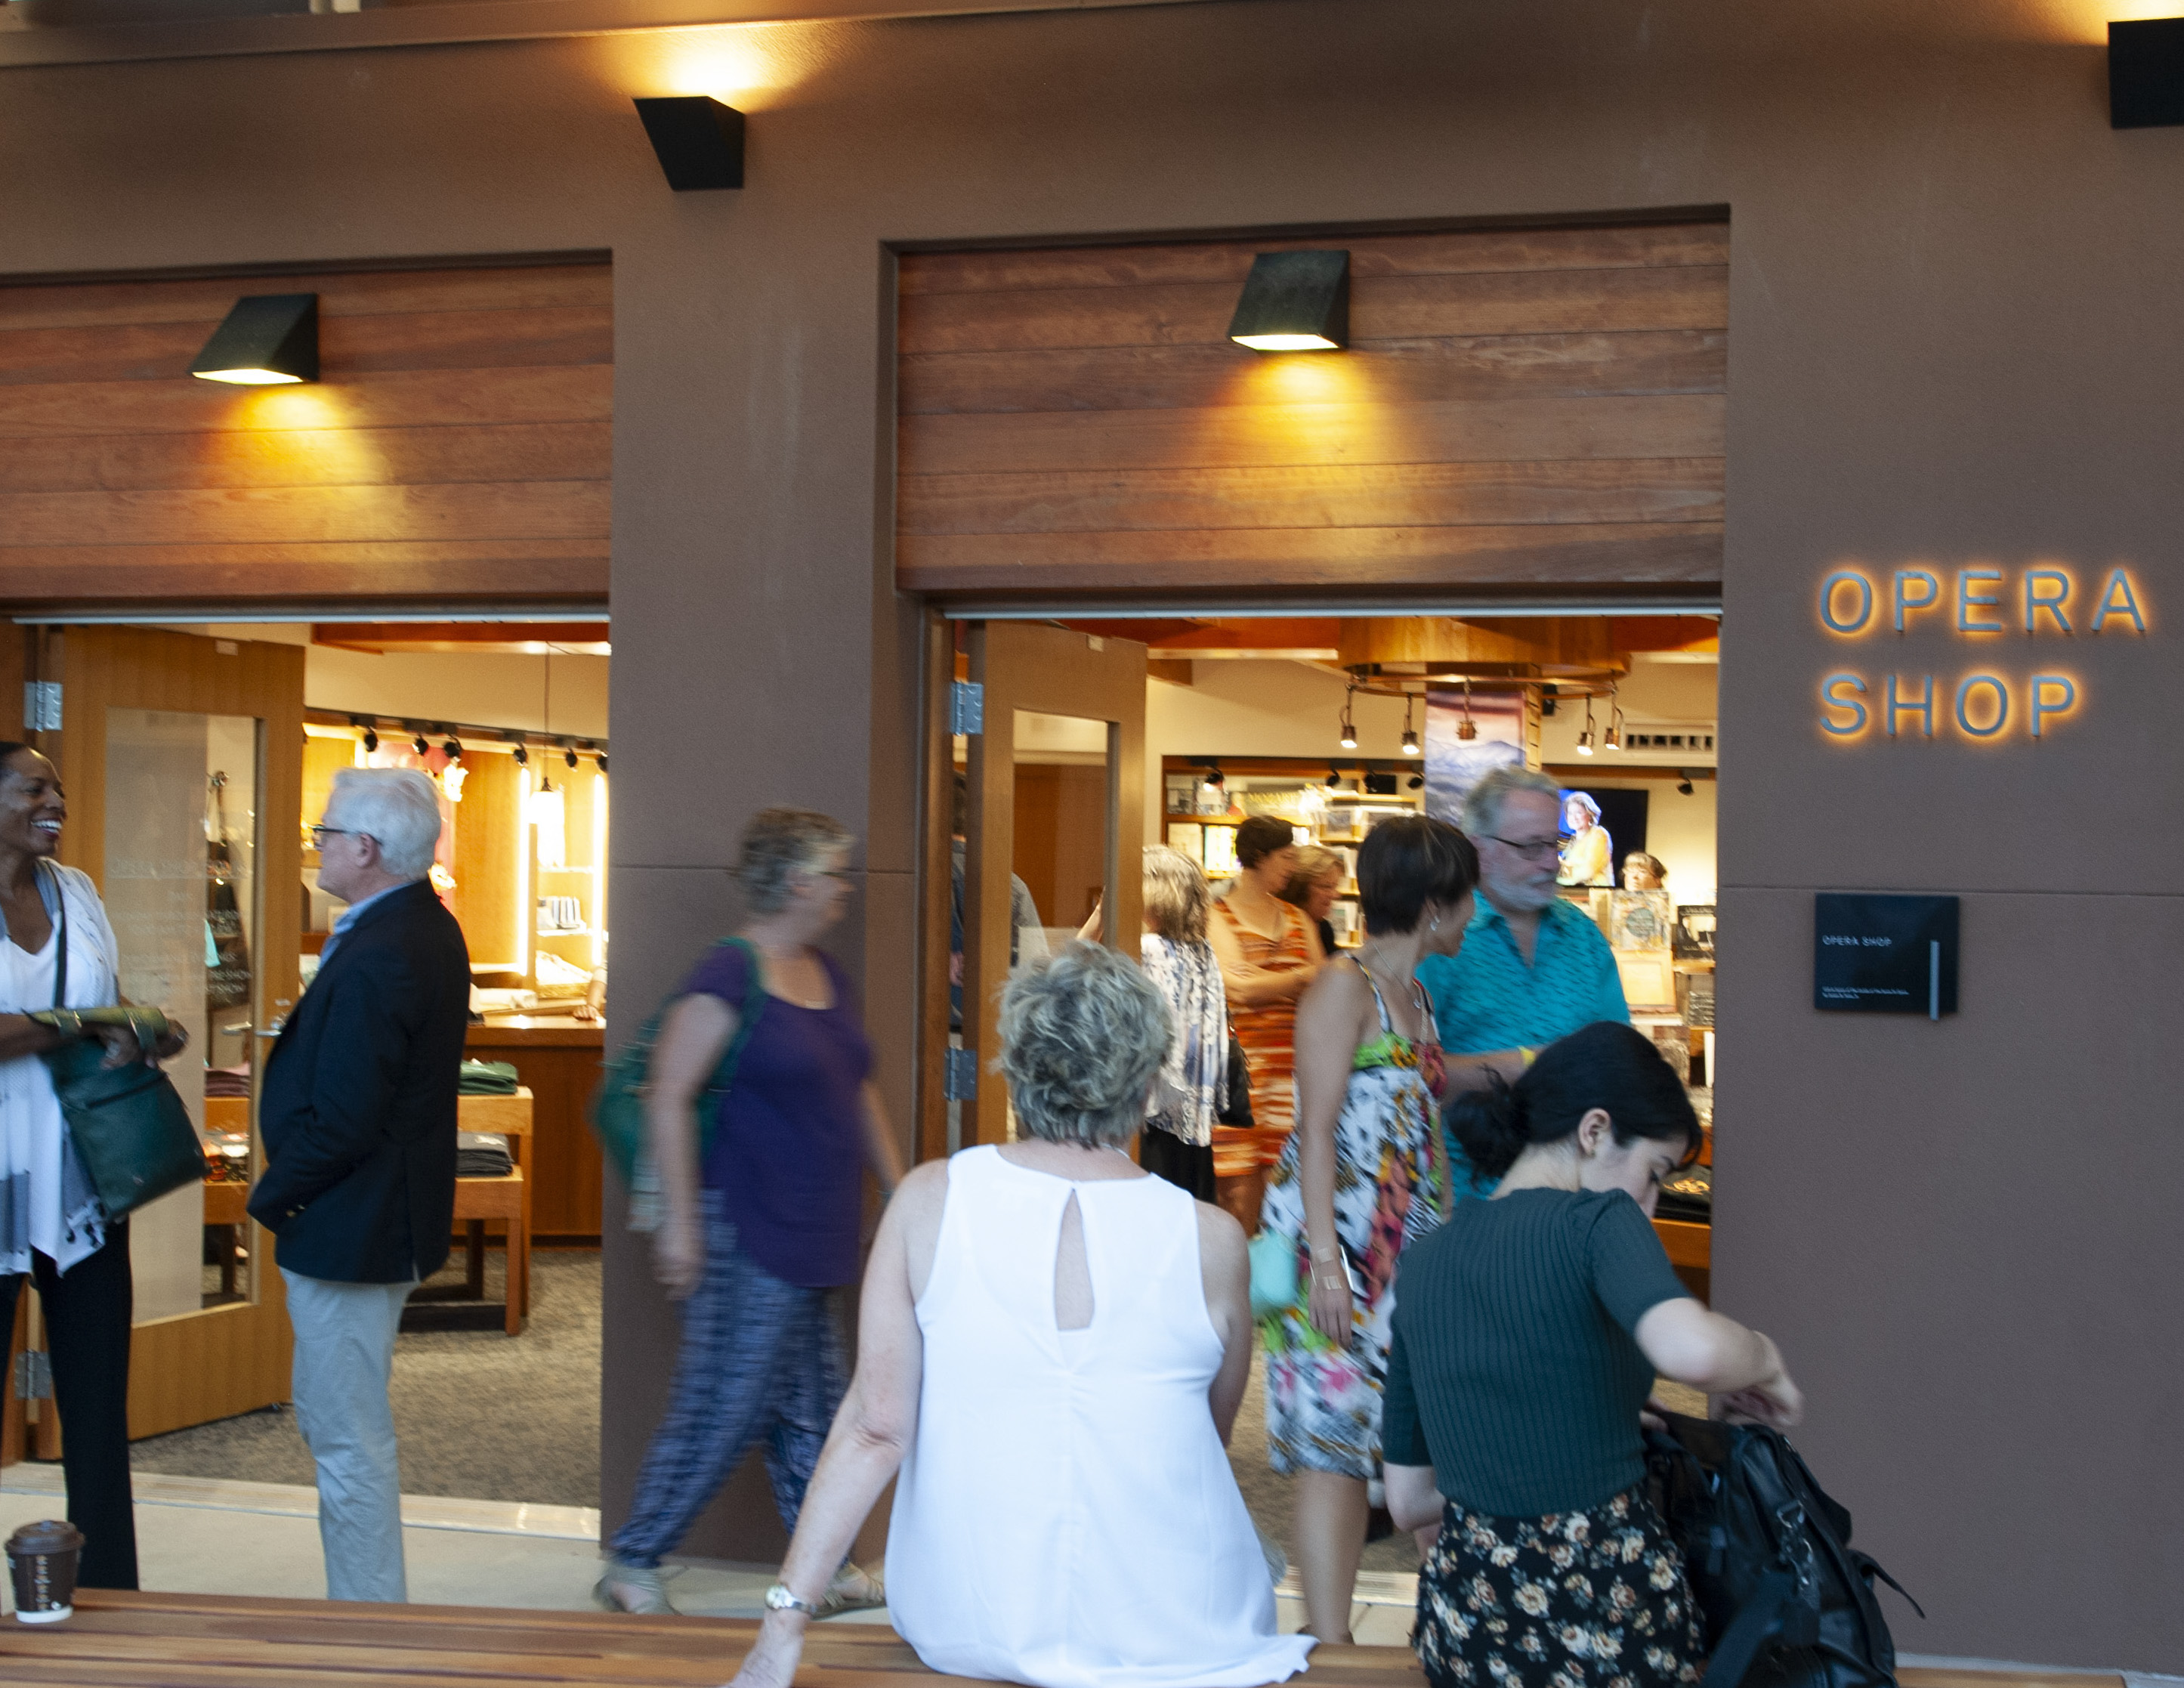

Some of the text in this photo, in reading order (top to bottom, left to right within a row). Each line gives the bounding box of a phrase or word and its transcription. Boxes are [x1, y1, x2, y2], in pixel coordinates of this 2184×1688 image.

[1820, 568, 2145, 632] OPERA
[1819, 674, 2075, 737] SHOP
[1822, 935, 1892, 947] OPERA SHOP
